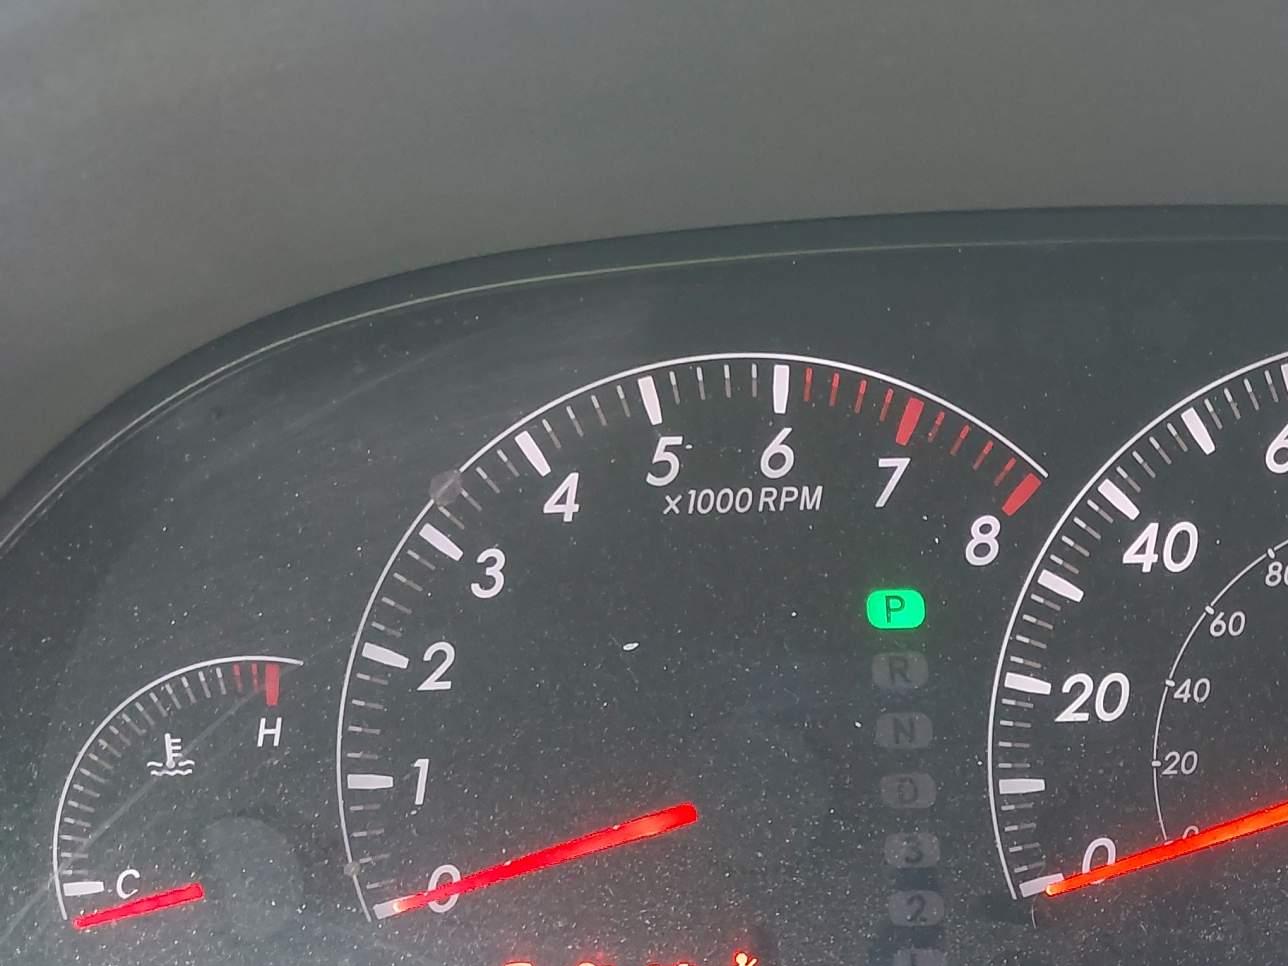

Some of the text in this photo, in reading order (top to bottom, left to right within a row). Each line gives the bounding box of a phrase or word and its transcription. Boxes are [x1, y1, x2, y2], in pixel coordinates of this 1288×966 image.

[646, 435, 682, 487] 5
[760, 427, 795, 479] 6
[543, 472, 580, 522] 4
[758, 485, 822, 512] RPM
[875, 457, 910, 508] 7
[965, 514, 1001, 566] 8
[1122, 520, 1199, 573] 40
[470, 547, 506, 599] 3
[885, 595, 905, 623] P
[1209, 610, 1246, 637] 60
[417, 641, 455, 691] 2
[888, 655, 911, 684] R
[1054, 672, 1131, 722] 20
[1173, 678, 1211, 703] 40
[257, 717, 282, 747] H
[894, 718, 914, 744] N
[413, 758, 430, 806] 1
[1161, 750, 1198, 775] 20
[905, 838, 923, 864] 3
[116, 868, 141, 900] C
[428, 864, 461, 913] 0
[907, 894, 927, 922] 2
